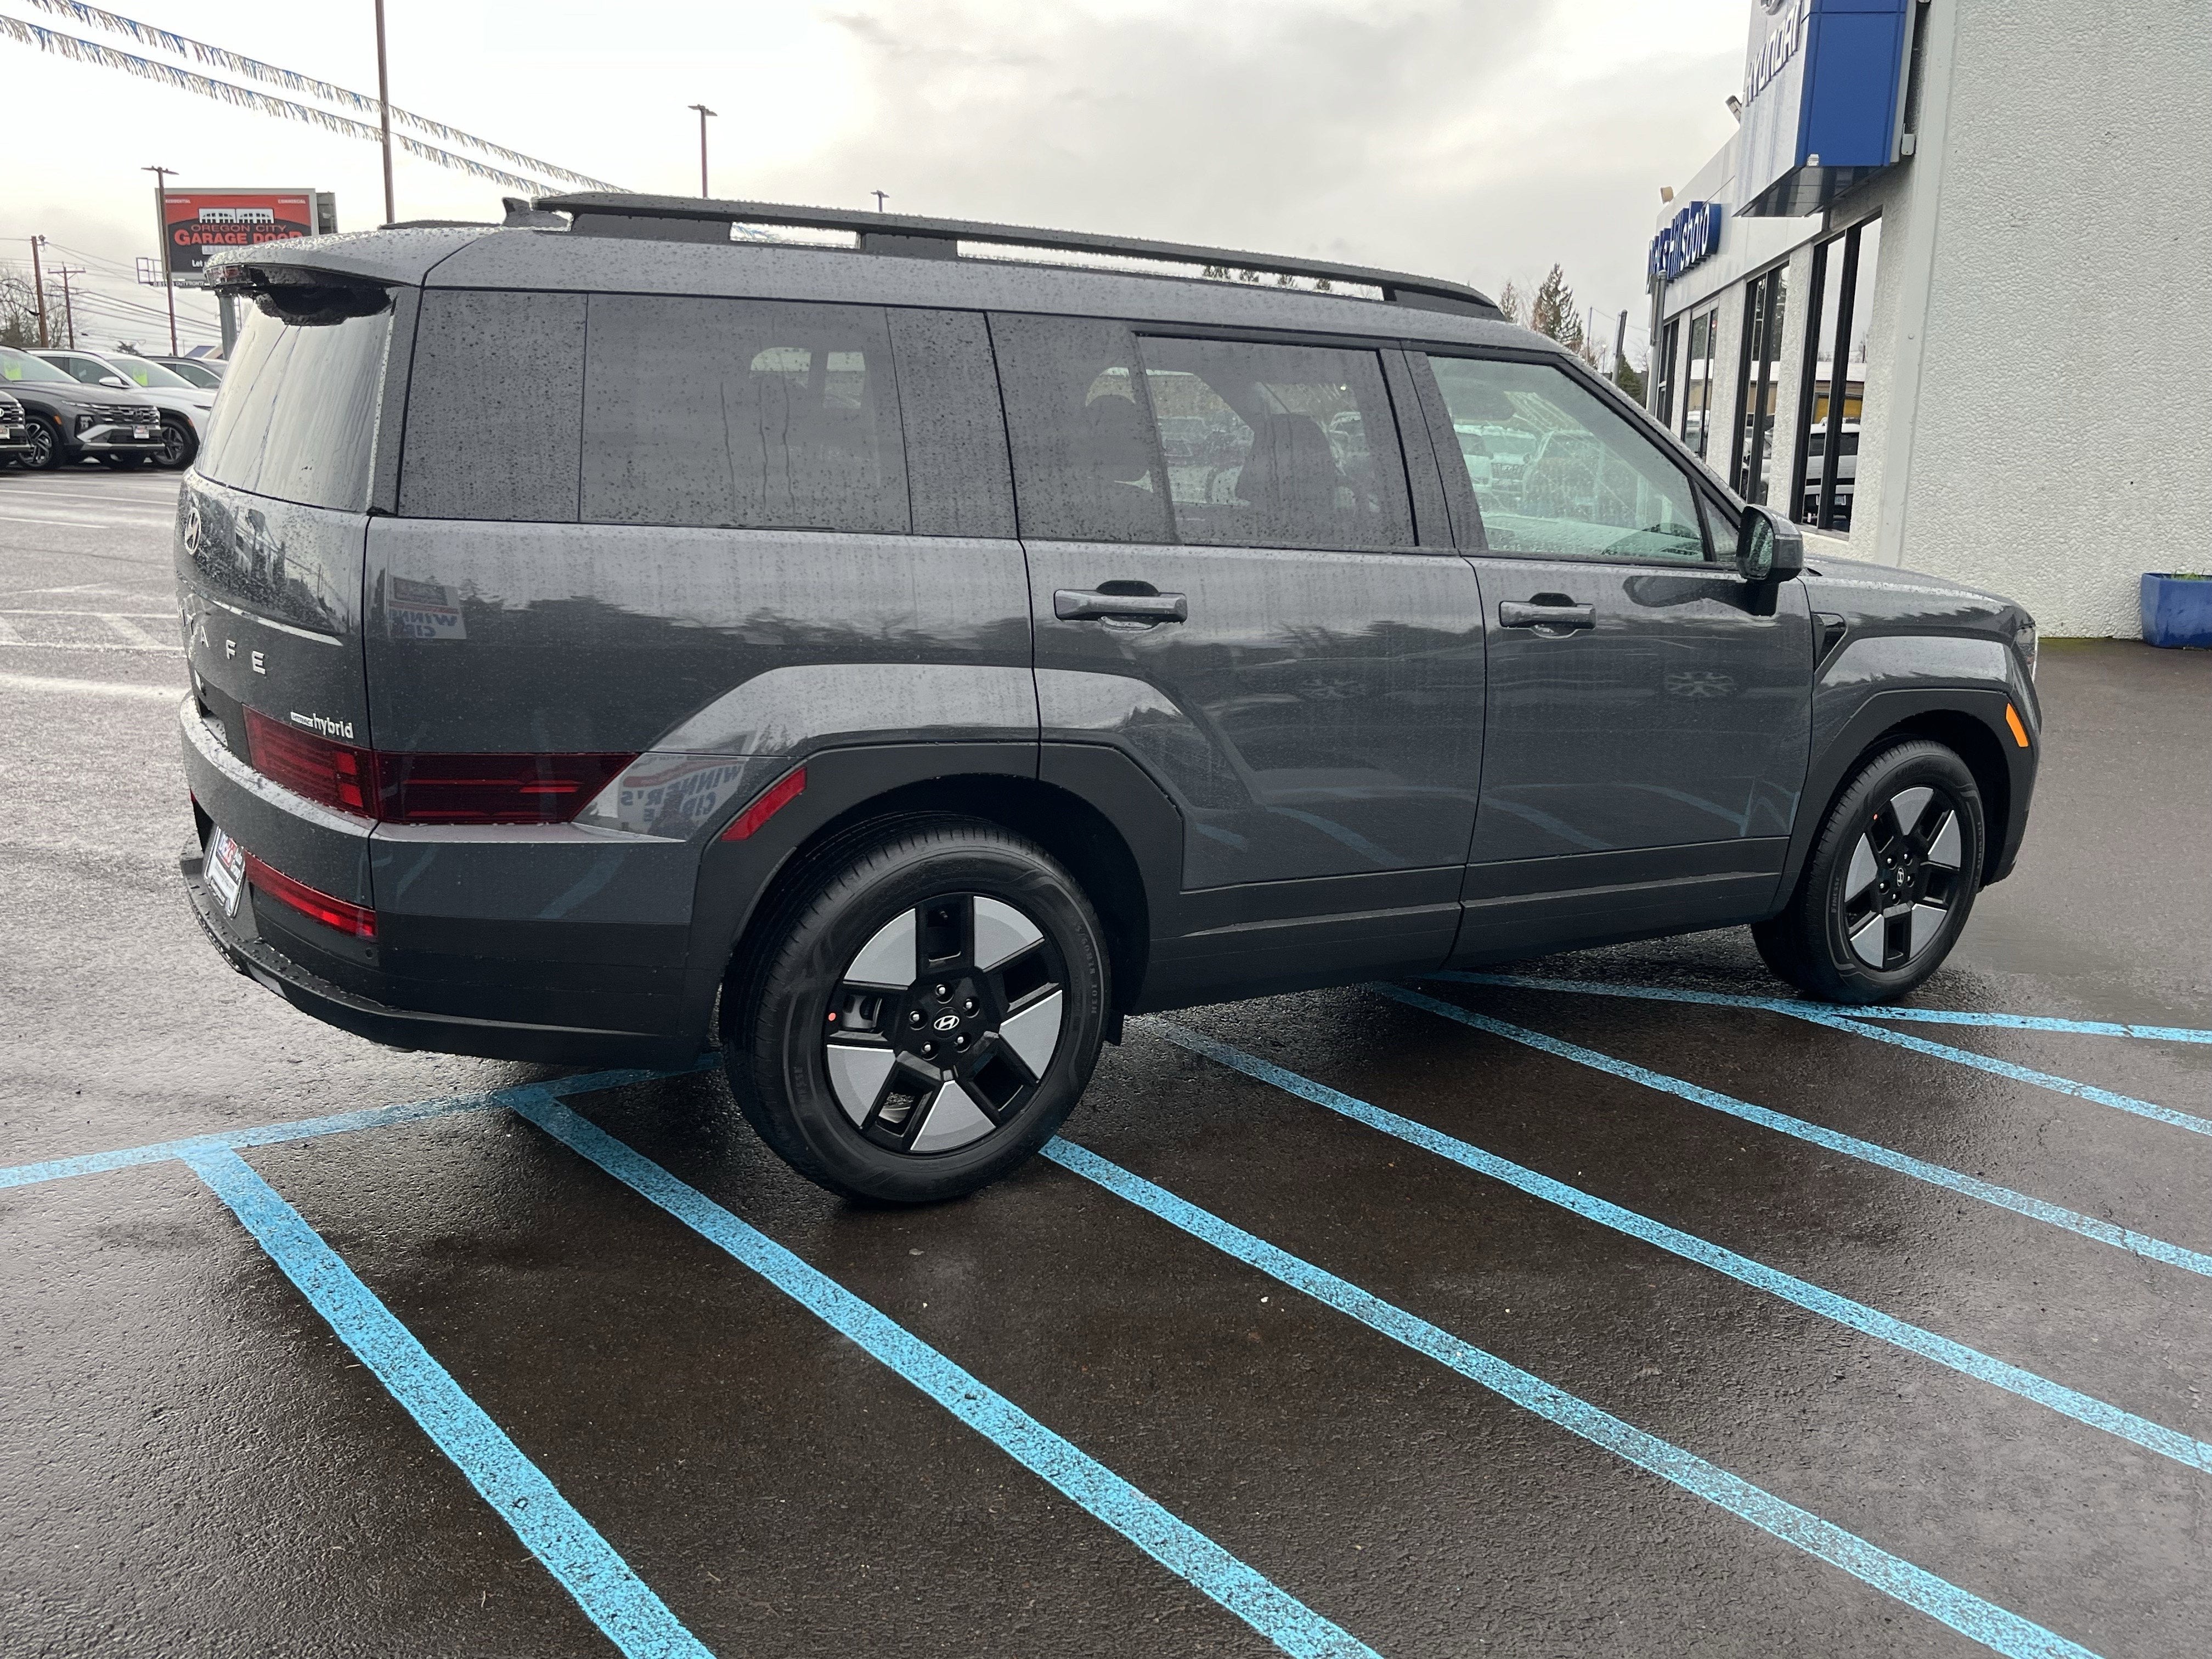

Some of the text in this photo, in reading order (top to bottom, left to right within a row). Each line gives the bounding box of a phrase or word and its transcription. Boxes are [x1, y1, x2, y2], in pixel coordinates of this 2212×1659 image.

[1745, 1, 1802, 107] HYUNDAI
[174, 229, 248, 246] GARAGE
[191, 224, 251, 232] OREGON
[313, 713, 354, 739] hybrid
